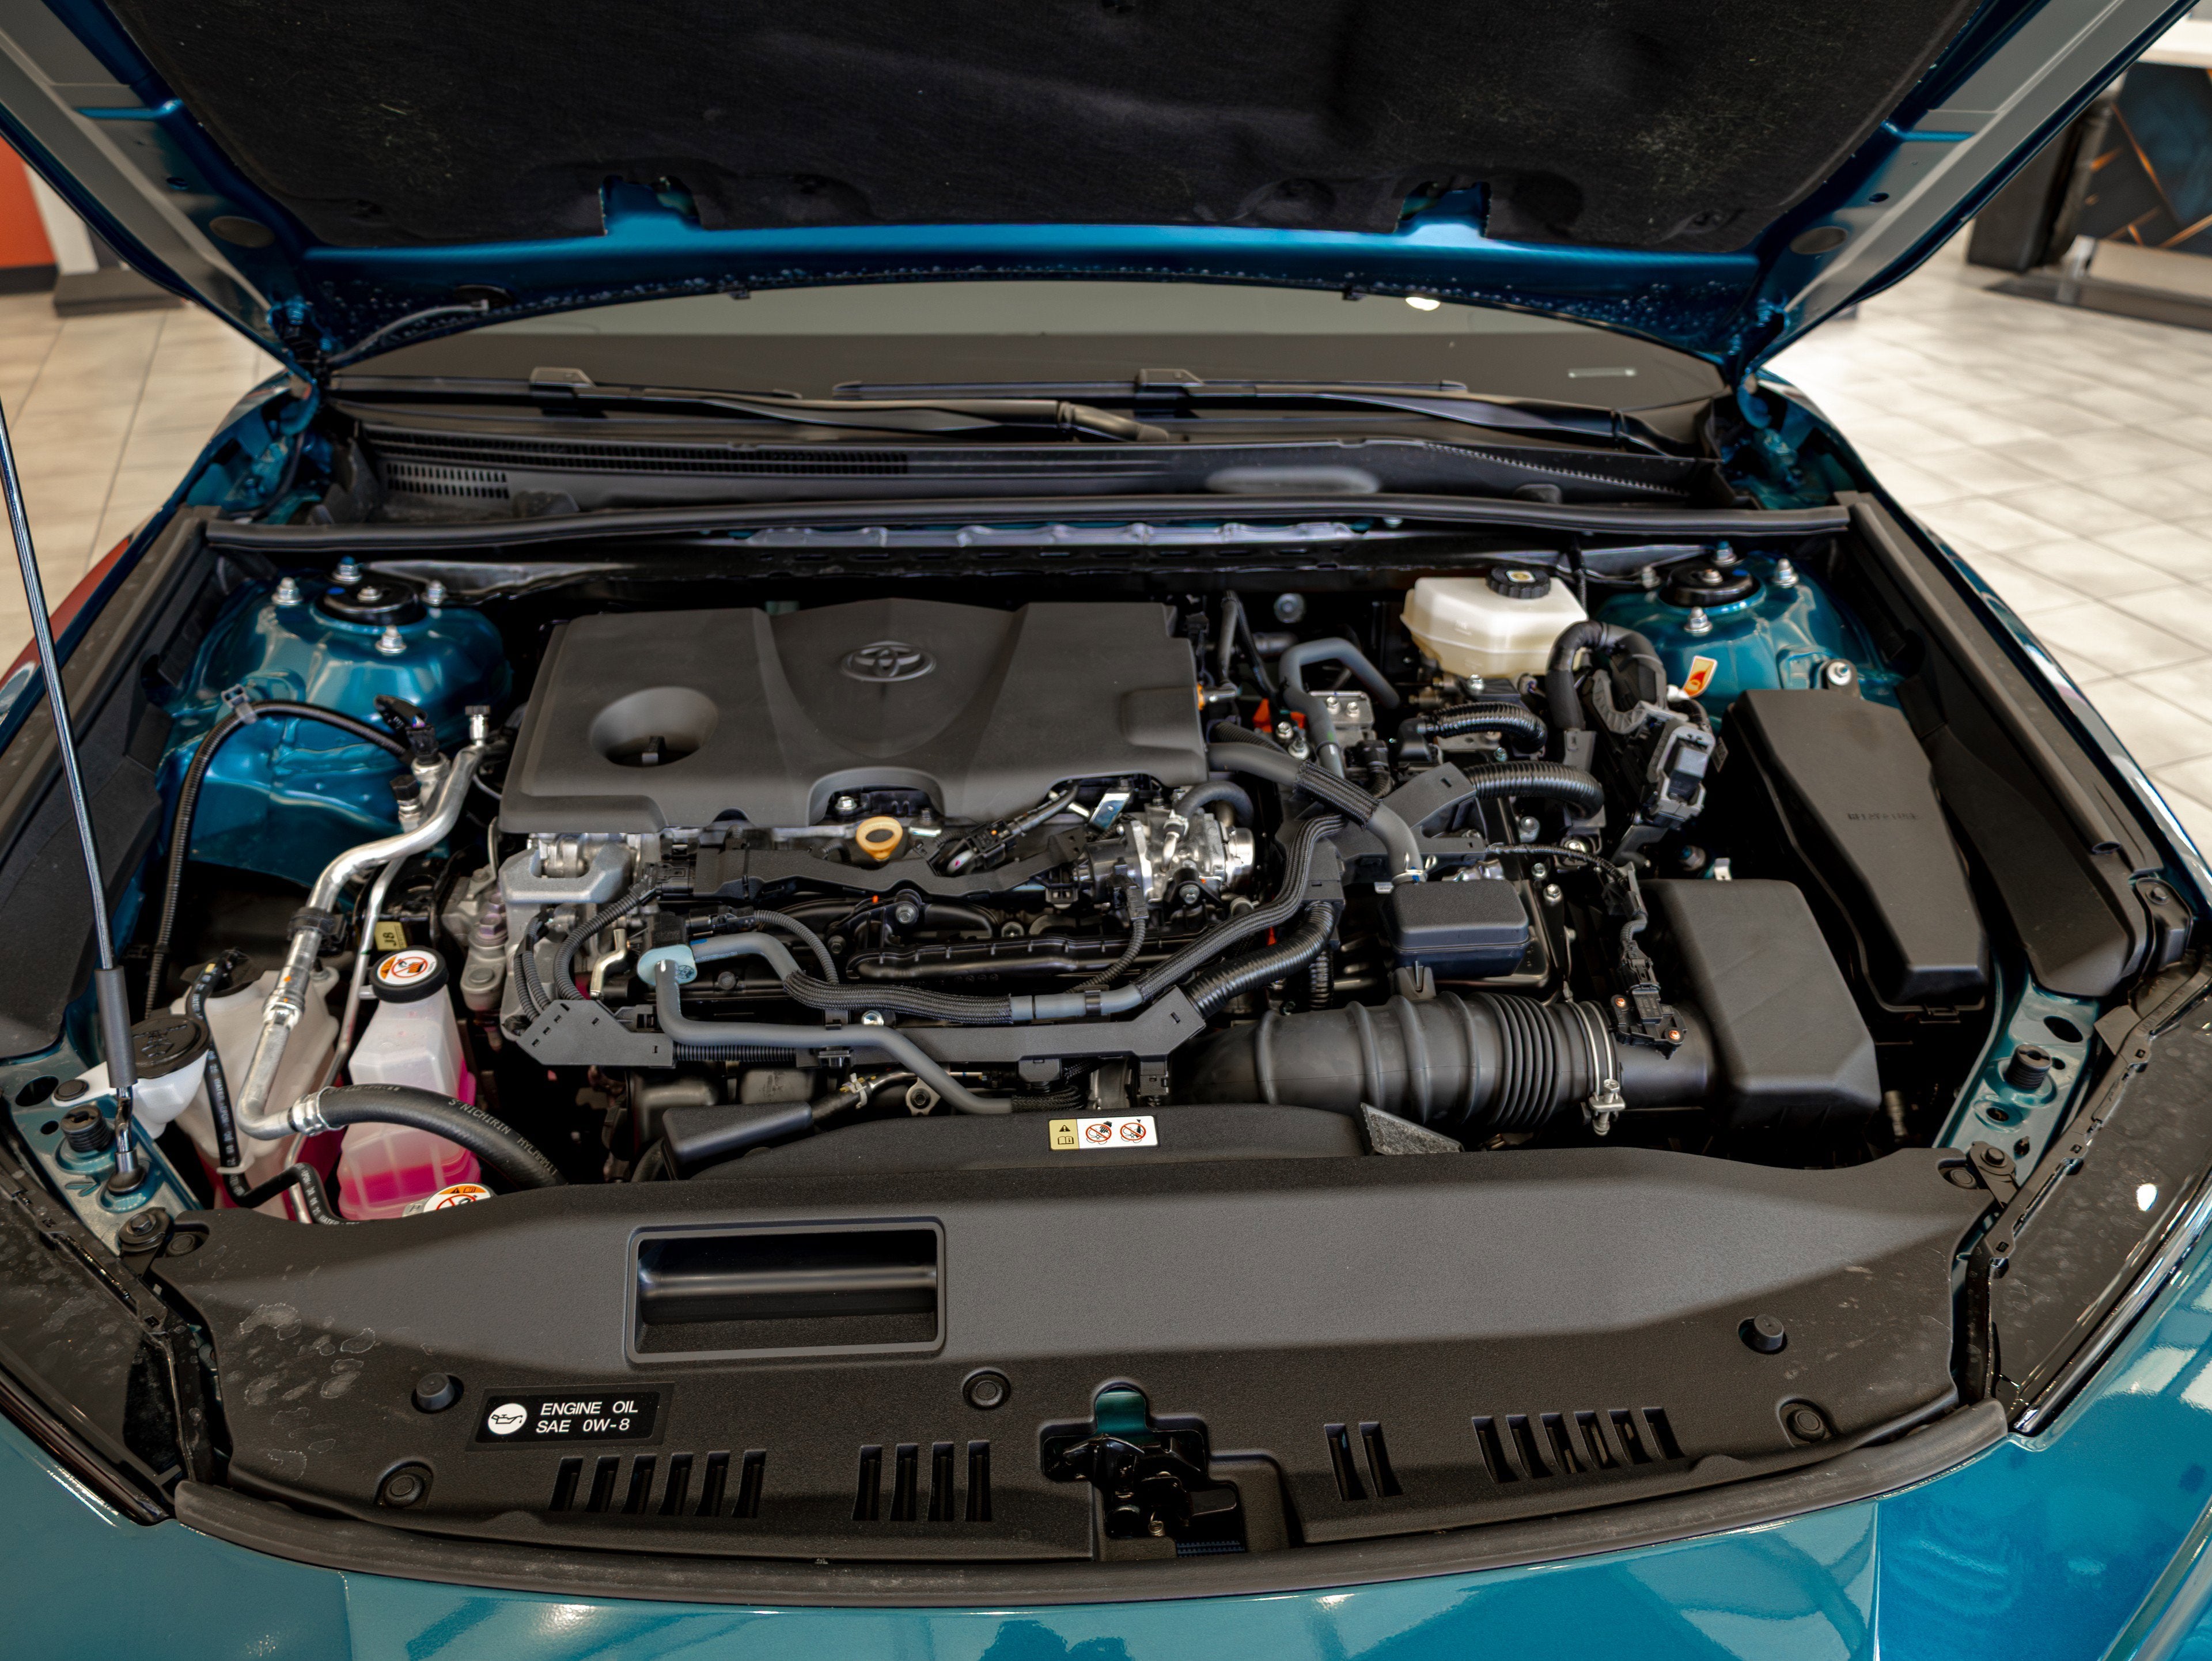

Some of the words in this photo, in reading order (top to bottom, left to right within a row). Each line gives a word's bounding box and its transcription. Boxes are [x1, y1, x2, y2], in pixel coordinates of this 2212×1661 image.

[460, 1103, 512, 1135] NICHIRIN
[540, 1401, 603, 1416] ENGINE
[612, 1400, 639, 1413] OIL
[535, 1419, 572, 1433] SAE
[582, 1417, 631, 1432] 0W-8
